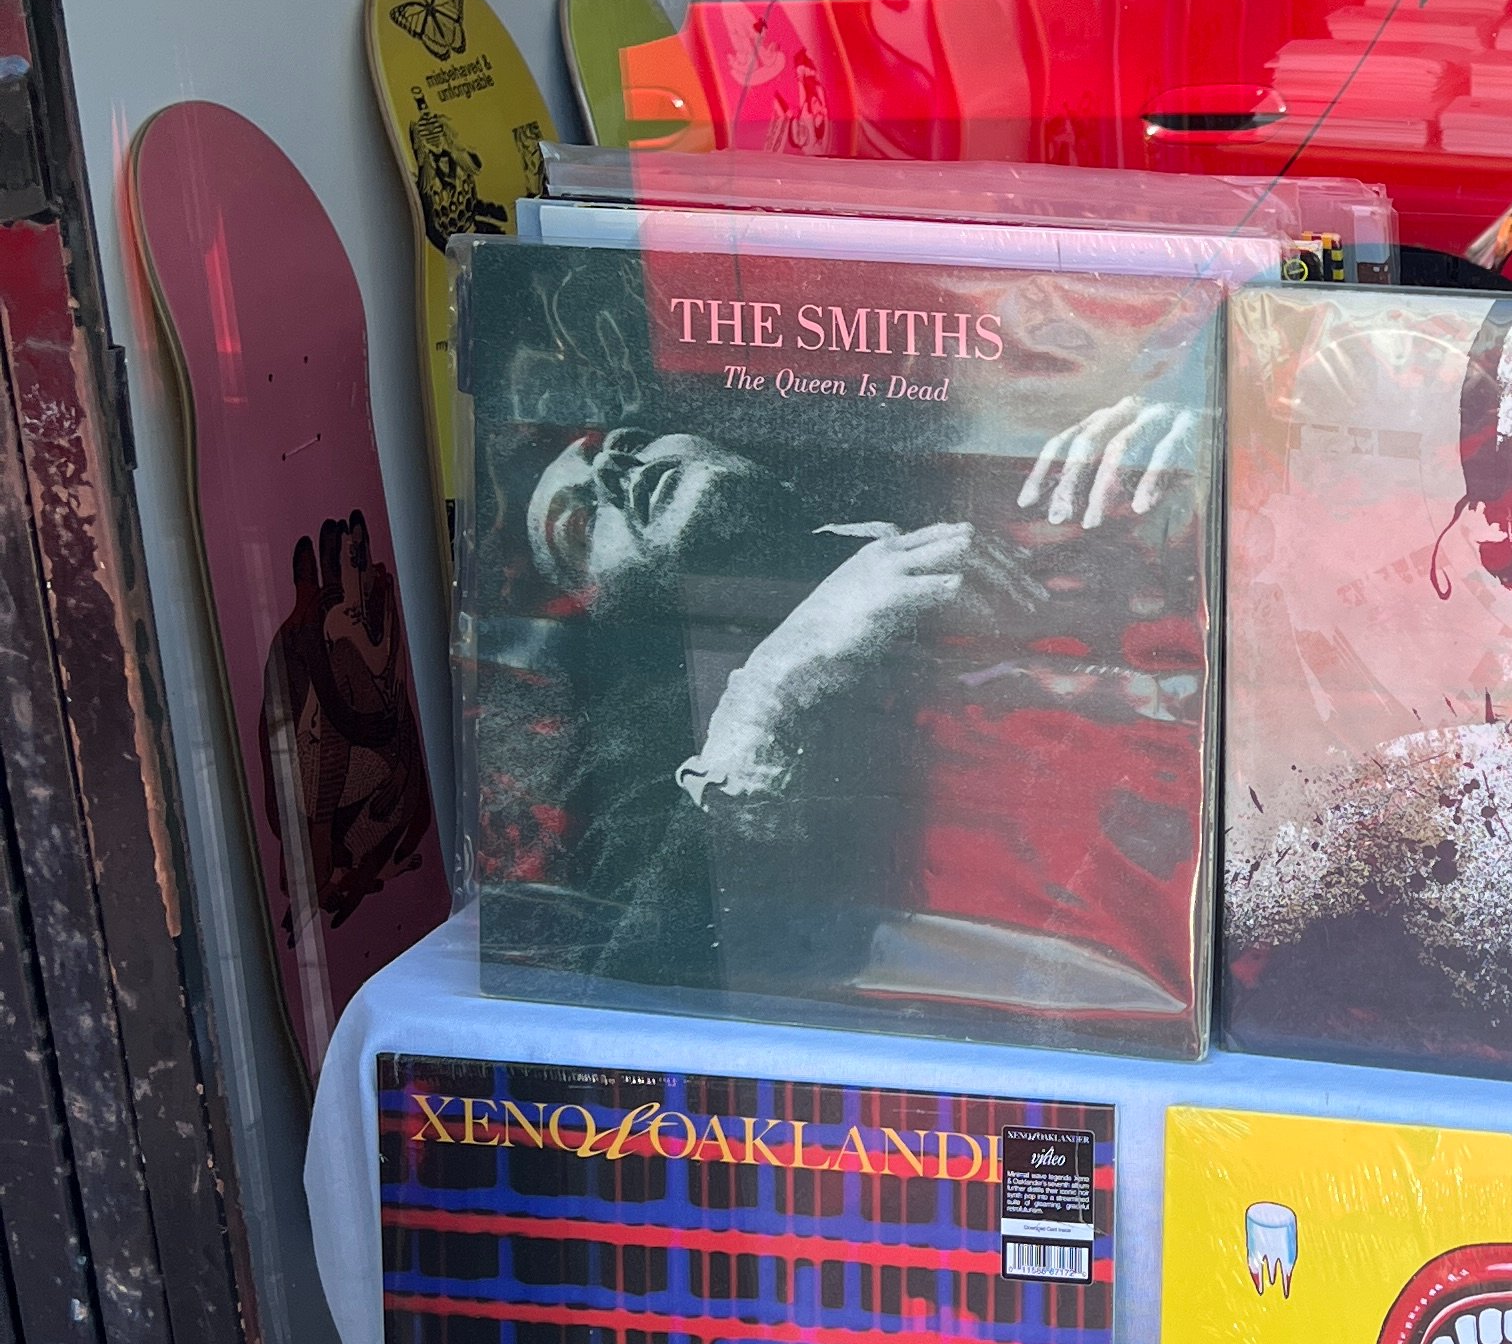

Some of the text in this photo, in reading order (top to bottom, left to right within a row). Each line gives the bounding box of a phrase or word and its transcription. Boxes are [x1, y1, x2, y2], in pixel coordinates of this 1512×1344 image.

[671, 298, 1004, 362] THE SMITHS
[724, 365, 950, 403] The Queen Is Dead
